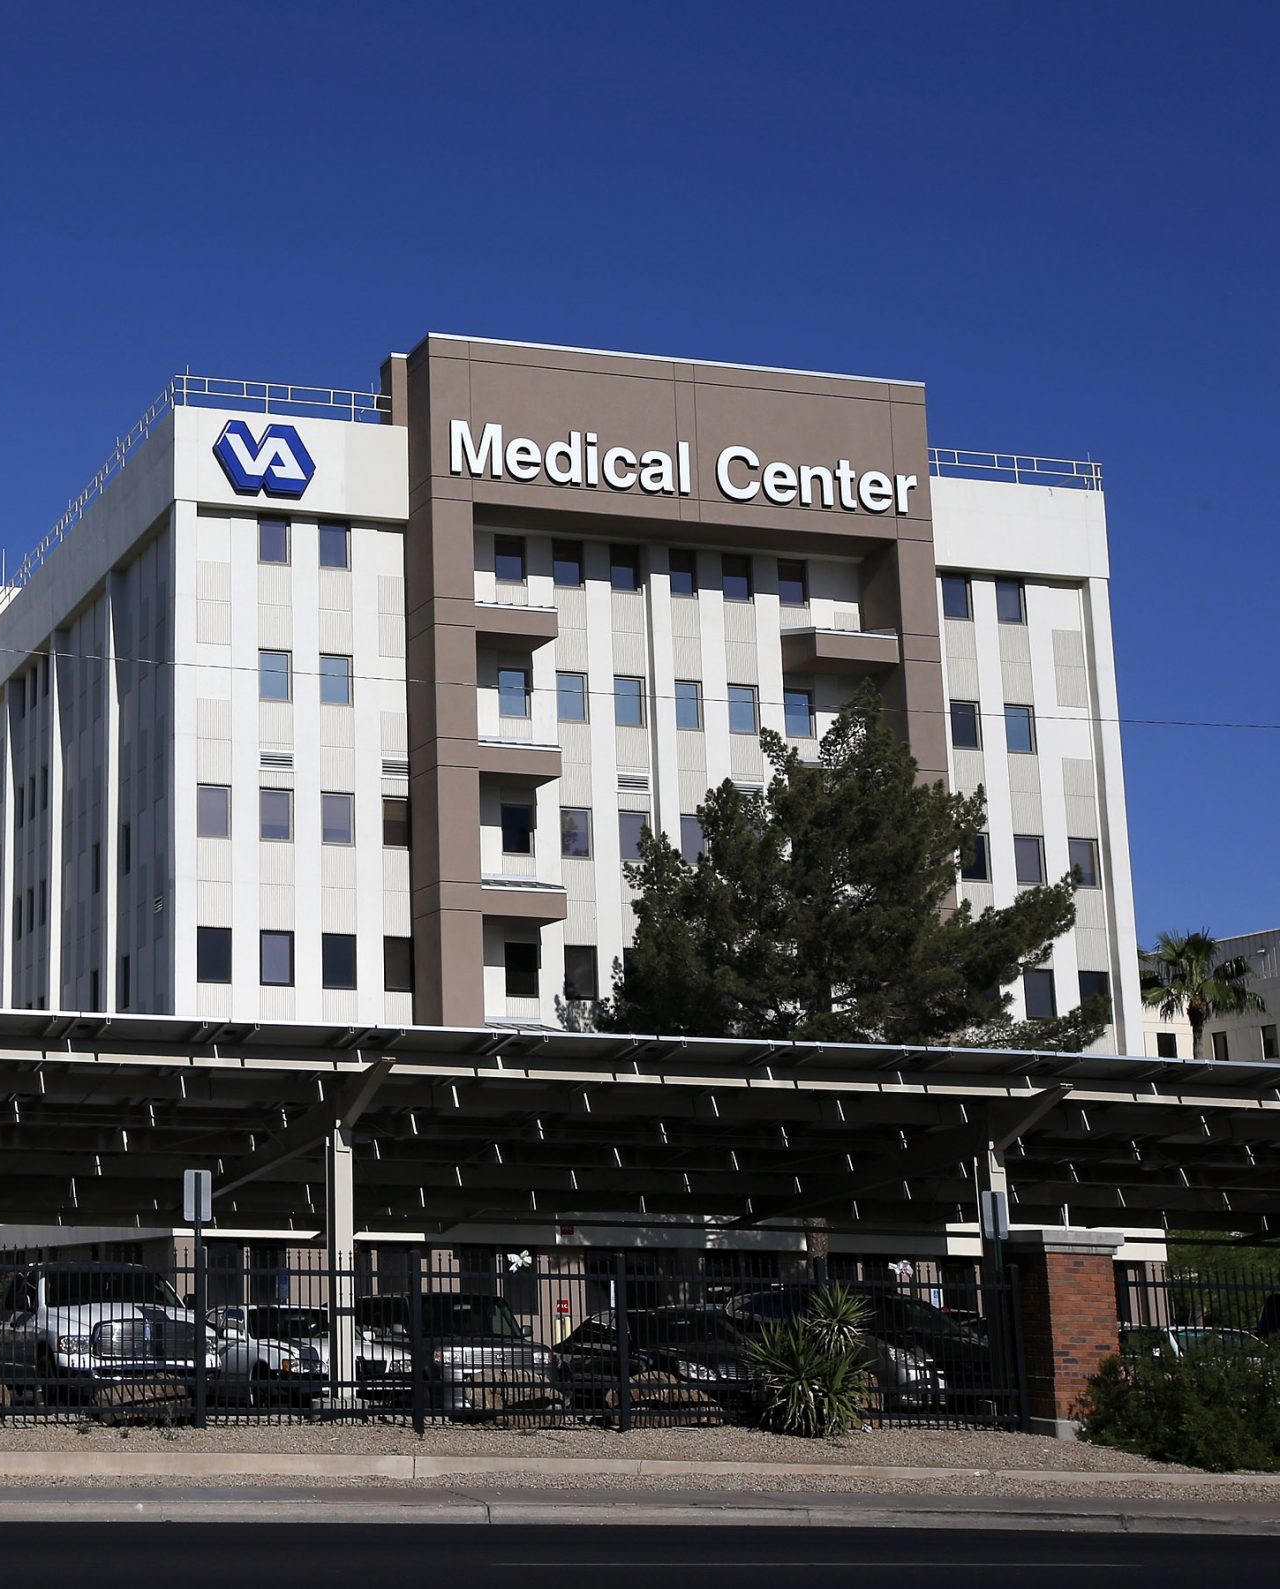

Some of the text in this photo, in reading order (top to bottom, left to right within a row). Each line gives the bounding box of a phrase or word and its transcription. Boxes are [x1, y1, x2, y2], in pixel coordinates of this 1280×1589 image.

[223, 431, 308, 481] VA
[450, 419, 918, 513] Medical Center
